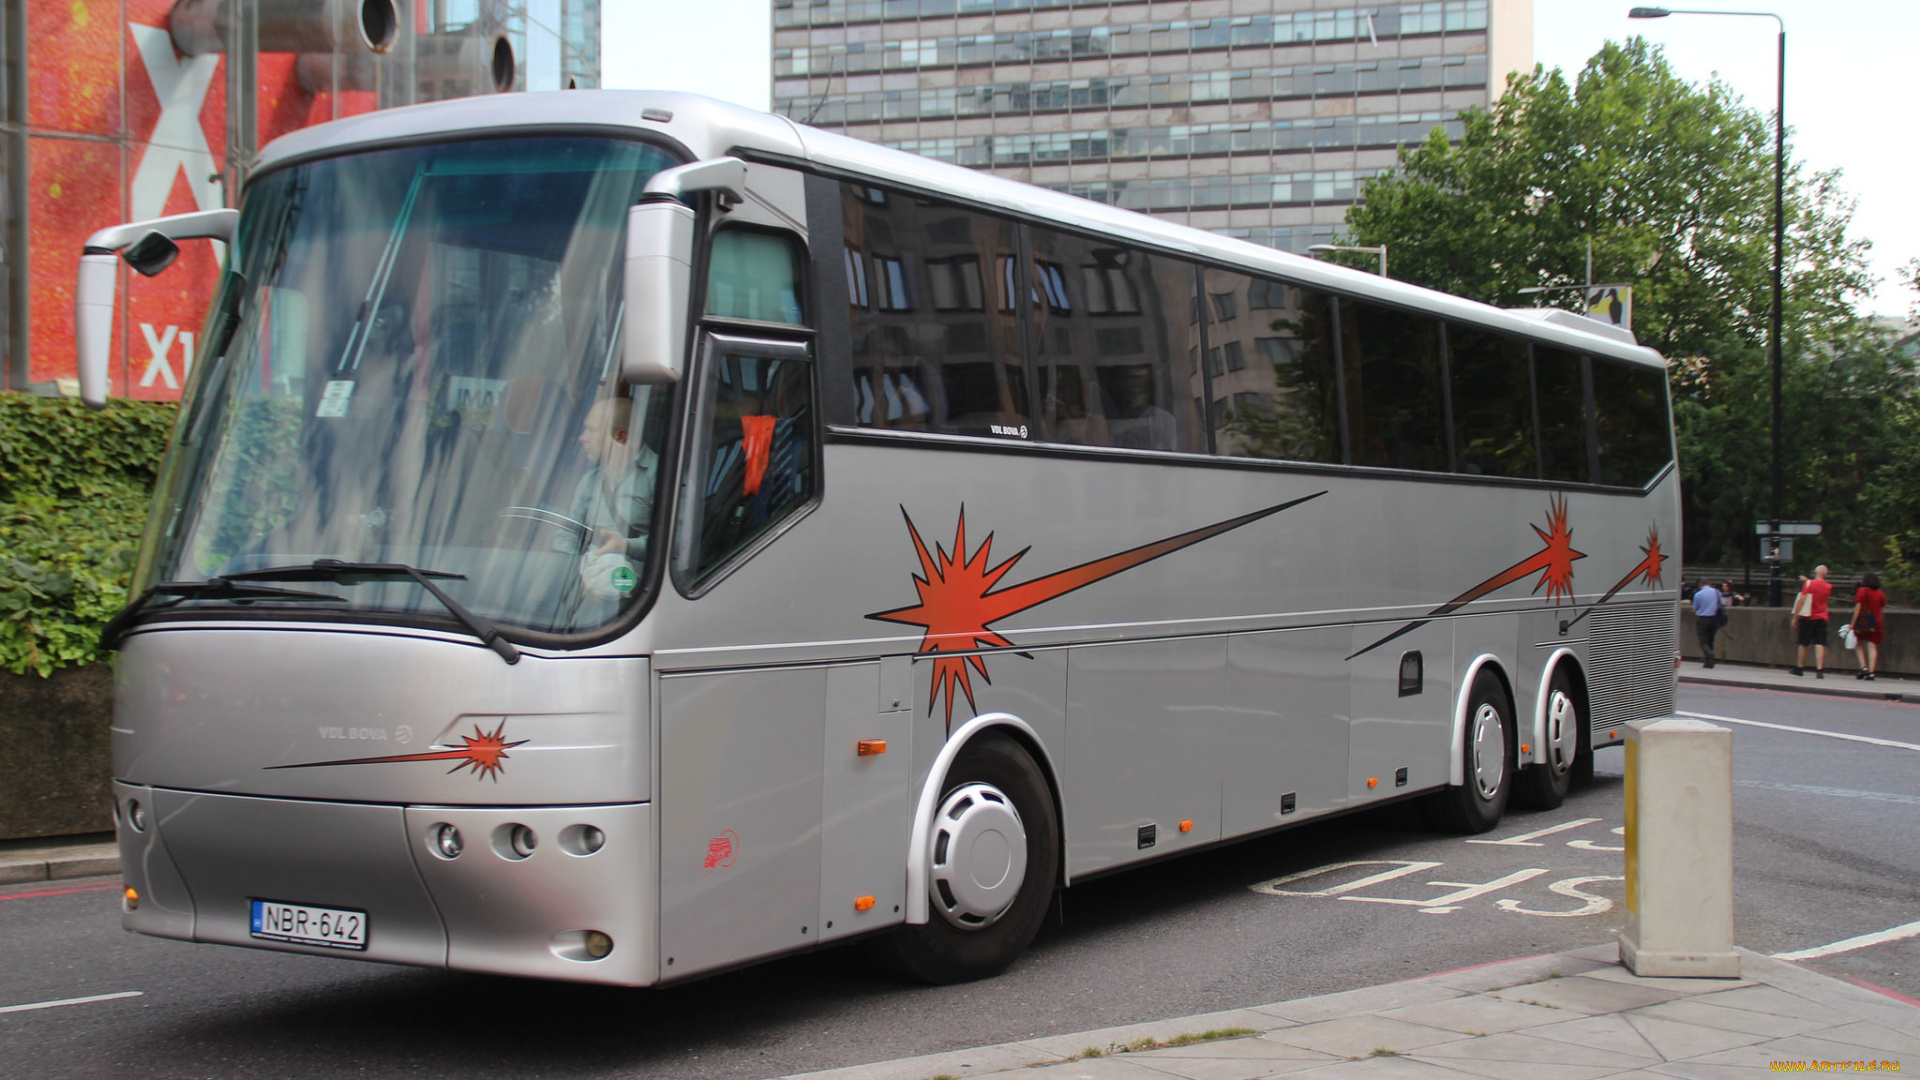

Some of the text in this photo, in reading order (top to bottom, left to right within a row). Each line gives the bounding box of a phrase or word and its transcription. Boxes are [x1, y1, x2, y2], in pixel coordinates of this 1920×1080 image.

[990, 424, 1019, 436] VDL BOVA
[319, 726, 388, 740] VDL BOVA
[266, 906, 360, 940] NBR-642
